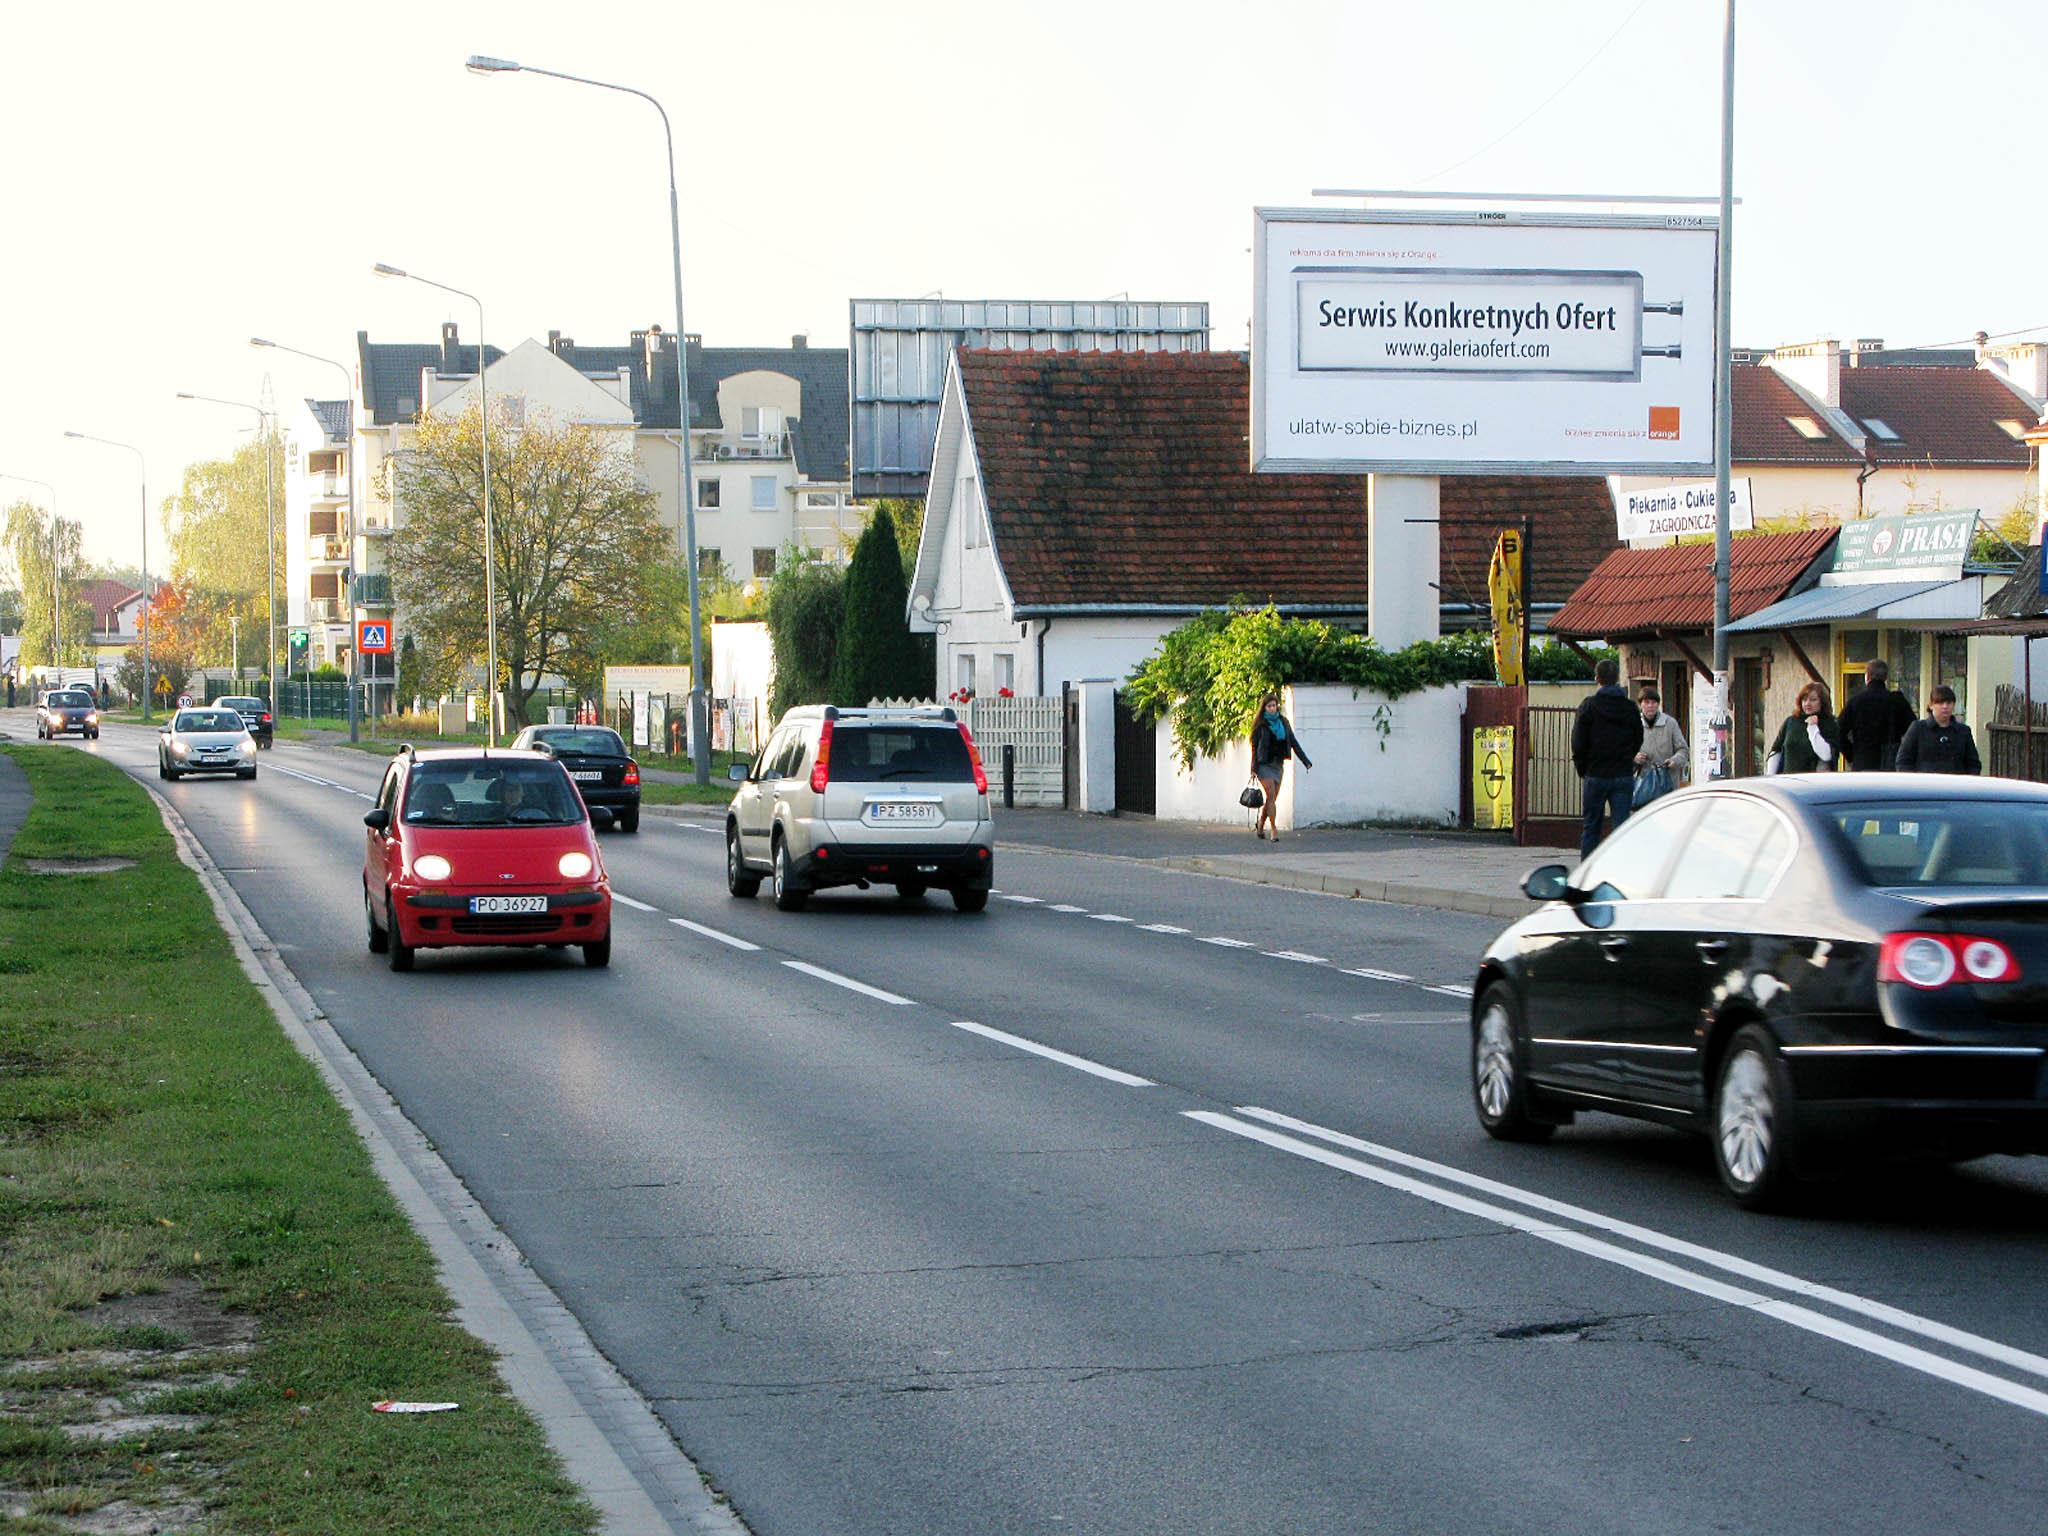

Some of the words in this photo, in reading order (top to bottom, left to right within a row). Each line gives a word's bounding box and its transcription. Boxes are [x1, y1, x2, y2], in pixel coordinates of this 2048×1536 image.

[1319, 300, 1397, 329] Serwis
[1404, 300, 1549, 335] Konkretnych
[1555, 302, 1617, 332] Ofert
[1385, 339, 1550, 361] www.galeriaofert.com
[1289, 418, 1478, 440] ulatw-sobie-biznes.pl
[1649, 430, 1678, 439] orange
[1629, 494, 1676, 515] Piekarnia
[1898, 522, 1968, 553] PRASA
[879, 805, 895, 818] PZ
[899, 805, 932, 818] 5858Y
[477, 898, 497, 912] PO
[503, 897, 545, 912] 36927
